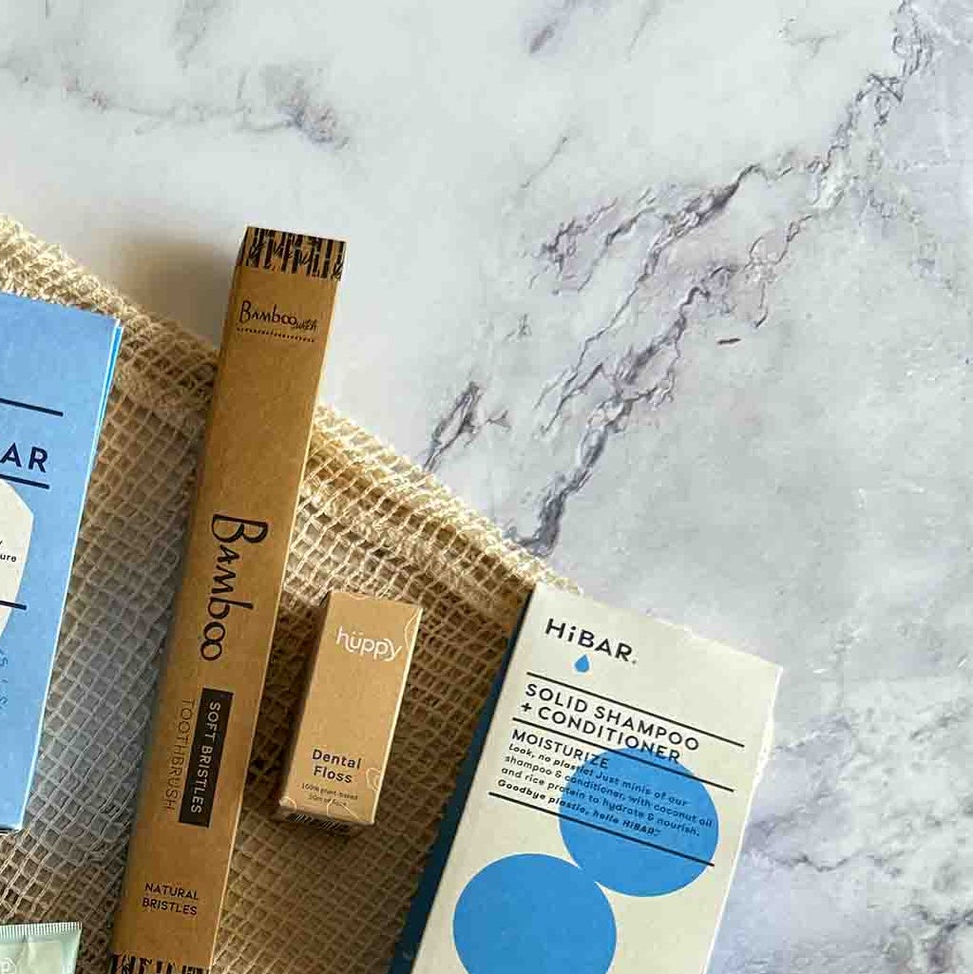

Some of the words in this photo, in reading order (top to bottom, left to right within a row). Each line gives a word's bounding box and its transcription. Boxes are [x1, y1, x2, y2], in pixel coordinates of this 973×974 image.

[200, 513, 269, 661] Bamboo
[335, 625, 403, 662] hüppy
[204, 701, 222, 741] SOFT
[525, 683, 588, 714] SOLID
[594, 705, 700, 752] SHAMPOO
[537, 705, 681, 764] CONDITIONER
[162, 698, 196, 811] TOOTHBRUSH
[311, 748, 363, 770] Dental
[313, 764, 353, 785] Floss
[508, 743, 535, 759] Look,
[538, 753, 552, 763] no
[595, 771, 619, 785] Just
[622, 780, 651, 795] minis
[654, 791, 667, 799] of
[668, 797, 688, 807] our
[511, 729, 609, 770] MOISTURIZE
[190, 745, 213, 814] BRISTLES
[497, 779, 547, 800] Goodbye
[592, 810, 620, 824] hello
[501, 767, 523, 778] and
[524, 774, 545, 786] rice
[547, 782, 586, 799] protein
[588, 794, 600, 804] to
[602, 797, 644, 817] hydrate
[647, 812, 655, 821] &
[657, 816, 700, 836] nourish.
[505, 755, 553, 776] shampoo
[554, 770, 562, 779] &
[564, 774, 626, 801] conditioner,
[628, 795, 651, 808] with
[654, 803, 697, 821] coconut
[699, 817, 713, 828] oil
[142, 897, 198, 916] BRISTLES
[144, 882, 200, 901] NATURAL
